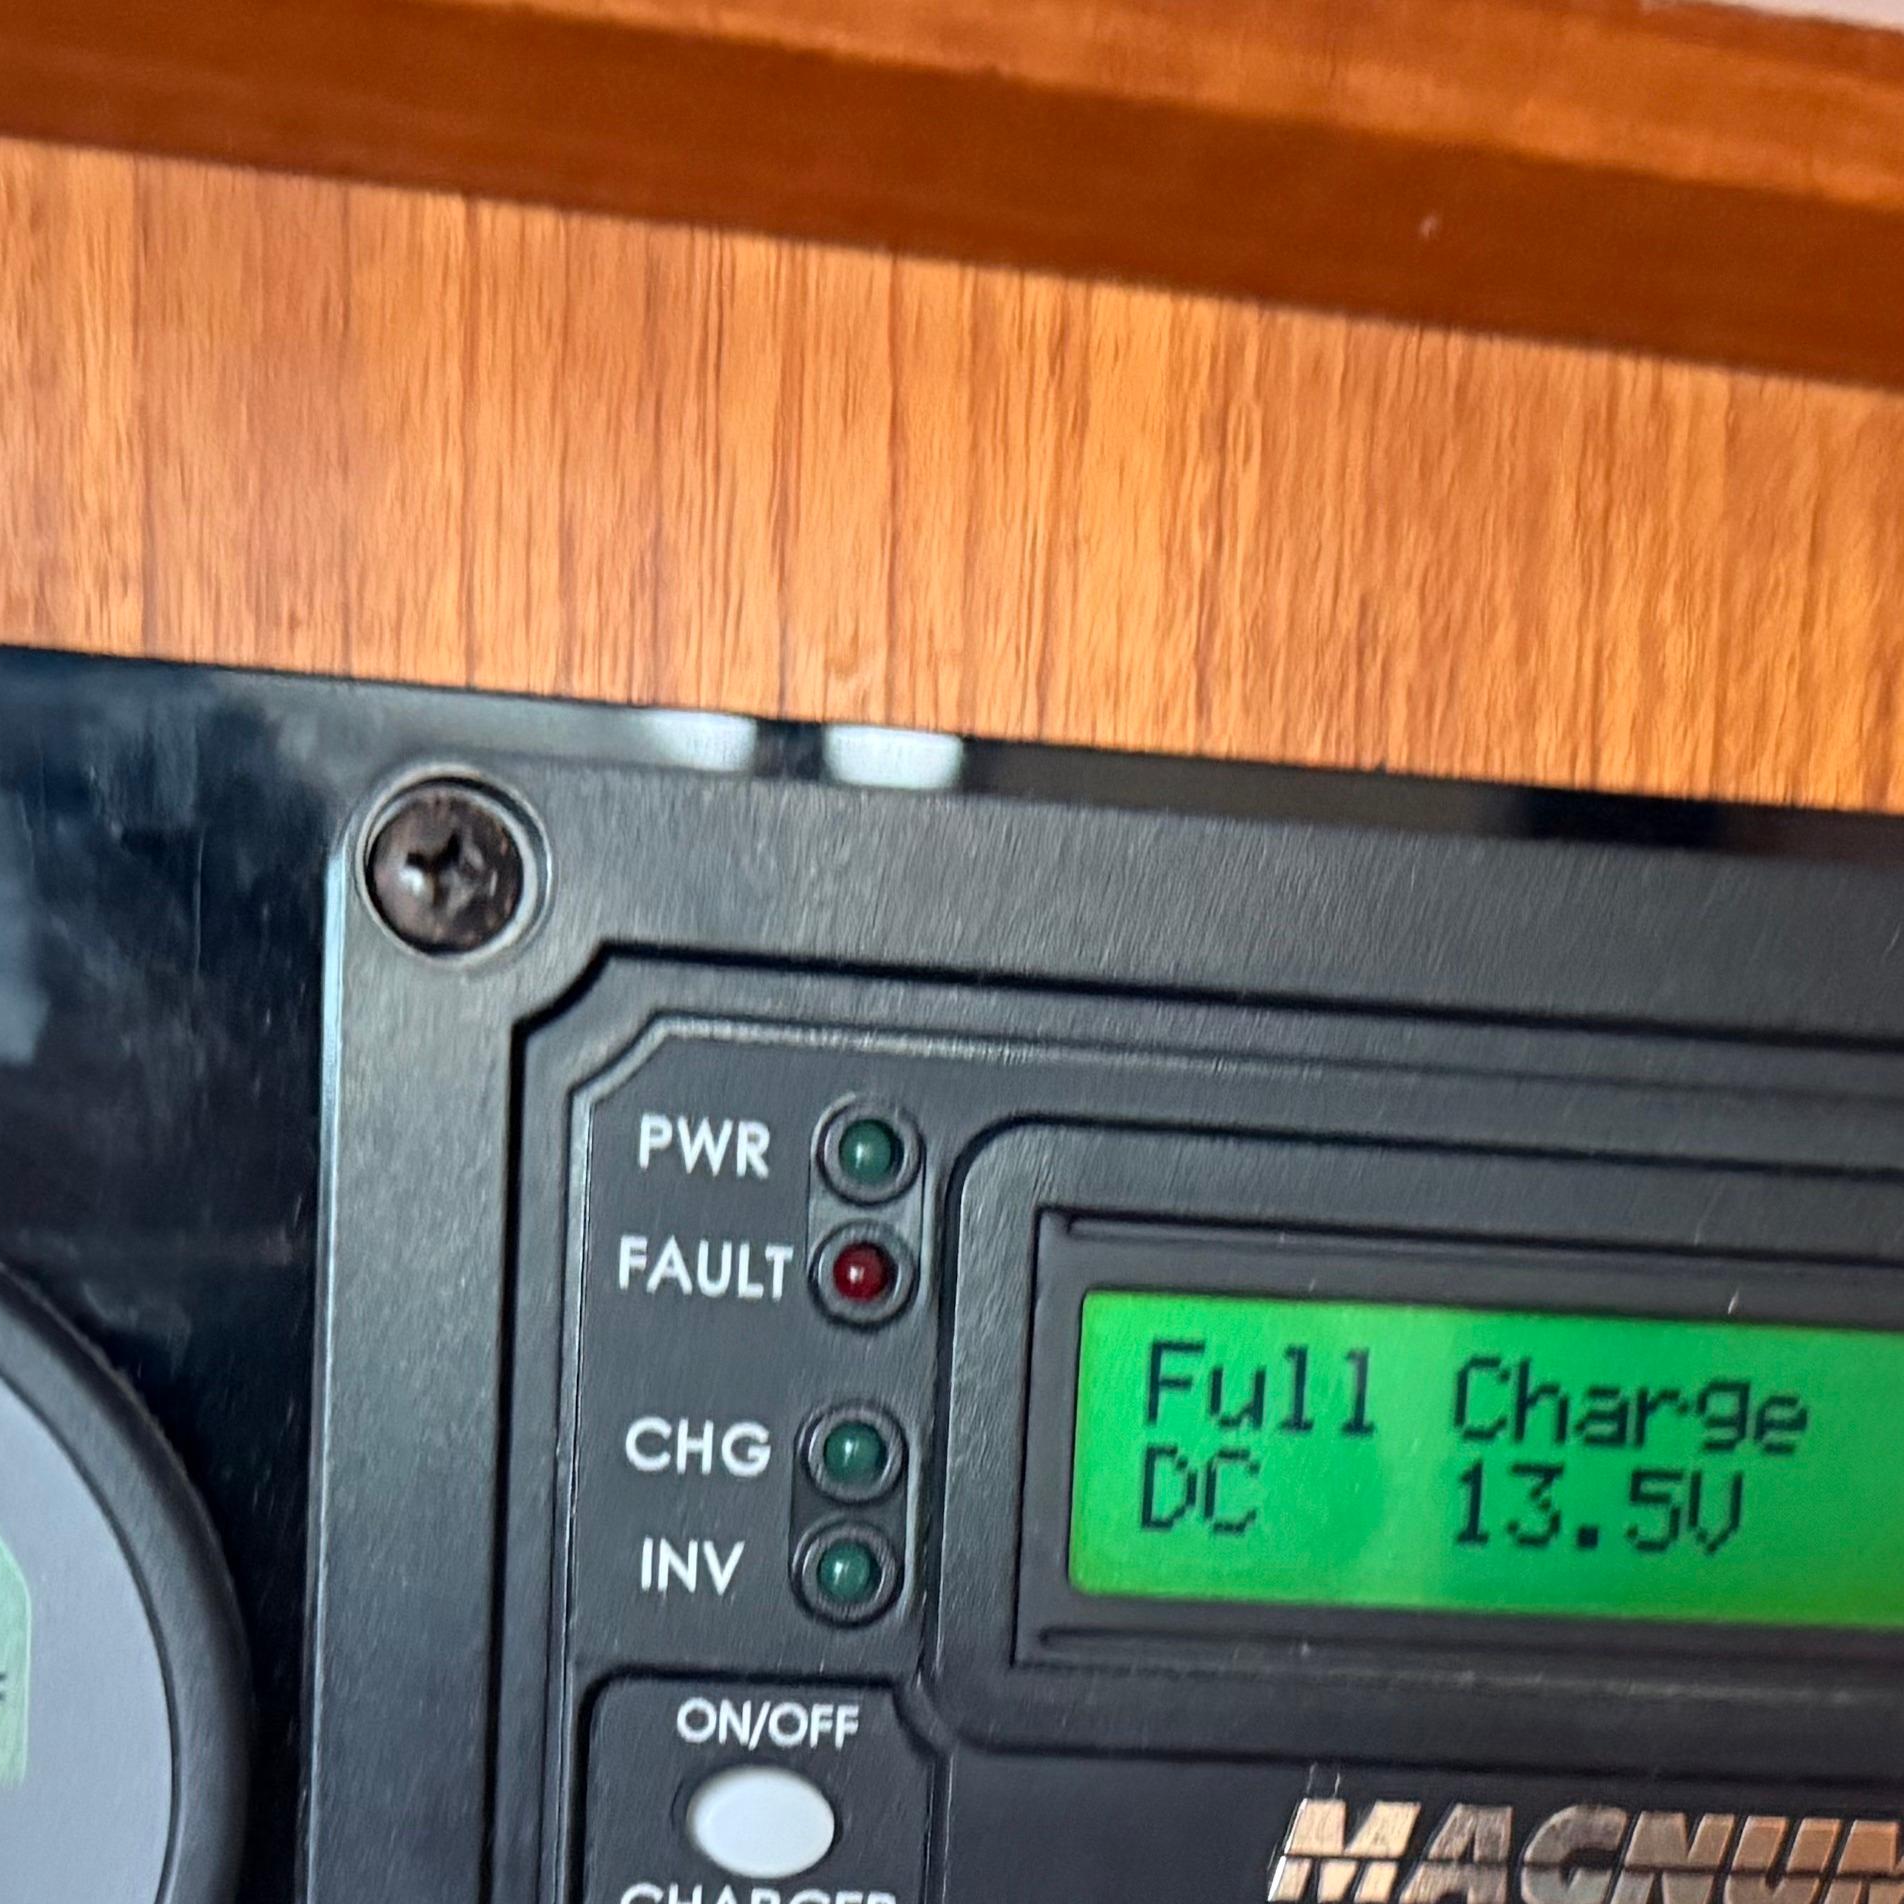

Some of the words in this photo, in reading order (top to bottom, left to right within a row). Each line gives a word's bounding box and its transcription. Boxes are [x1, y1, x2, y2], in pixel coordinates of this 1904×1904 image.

[637, 1114, 770, 1178] PWR
[618, 1234, 793, 1300] FAULT
[1142, 1338, 1374, 1440] Full
[1452, 1355, 1810, 1454] Charge
[624, 1417, 772, 1476] CHG
[1138, 1445, 1258, 1534] DC
[1456, 1460, 1746, 1555] 13.5V
[640, 1537, 745, 1596] INV
[675, 1698, 860, 1748] ON/OFF
